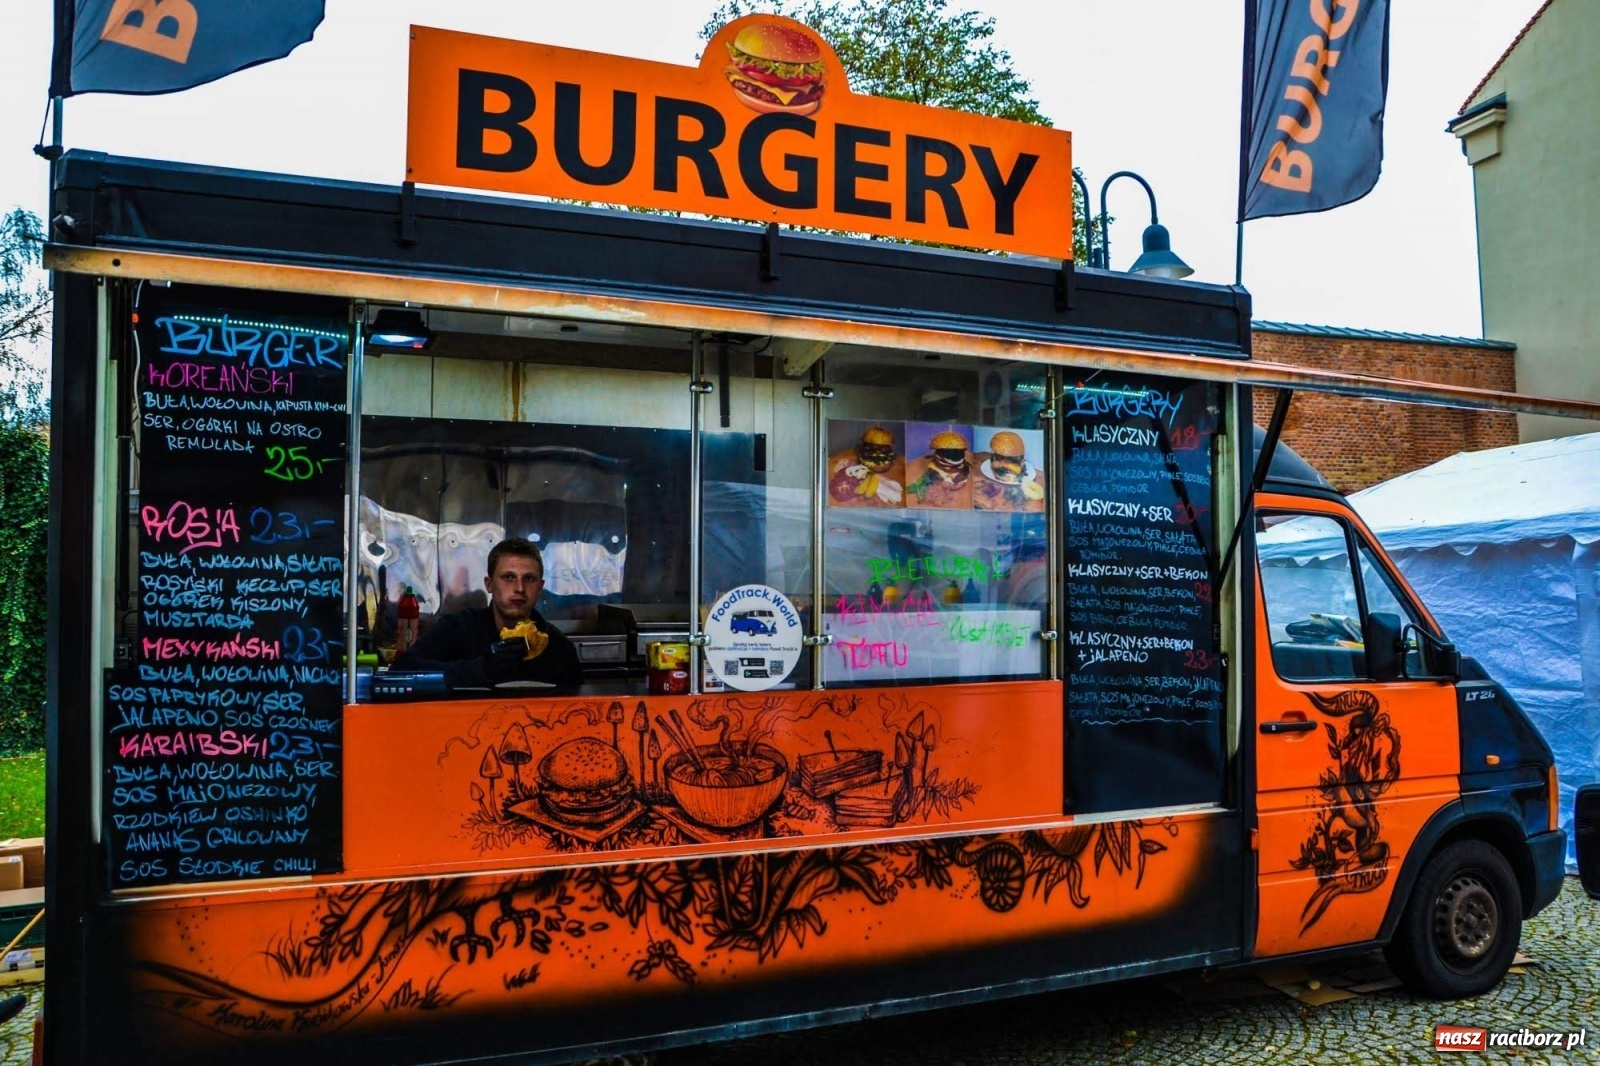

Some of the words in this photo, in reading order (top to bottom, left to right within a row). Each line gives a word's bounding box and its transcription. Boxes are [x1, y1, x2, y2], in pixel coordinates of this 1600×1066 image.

[456, 68, 1039, 236] BURGERY
[155, 314, 343, 370] BURGER
[149, 362, 294, 395] KOREAŃSKI
[1067, 382, 1183, 428] BURGERY
[246, 421, 263, 436] NA
[269, 422, 322, 439] OSTRO
[1072, 424, 1159, 447] KLASYCZNY
[308, 578, 343, 598] SER
[143, 610, 254, 629] MUSZTARDA
[109, 685, 147, 702] SOS
[1465, 692, 1479, 702] LT
[224, 709, 264, 728] SOS
[119, 729, 268, 760] KARAIBSKI
[112, 786, 157, 806] SOS
[113, 807, 218, 830] RZODKIEW
[126, 828, 201, 853] ANANAS
[119, 859, 168, 882] SOS
[178, 856, 265, 878] SŁODKIE
[274, 857, 317, 873] CHILLI
